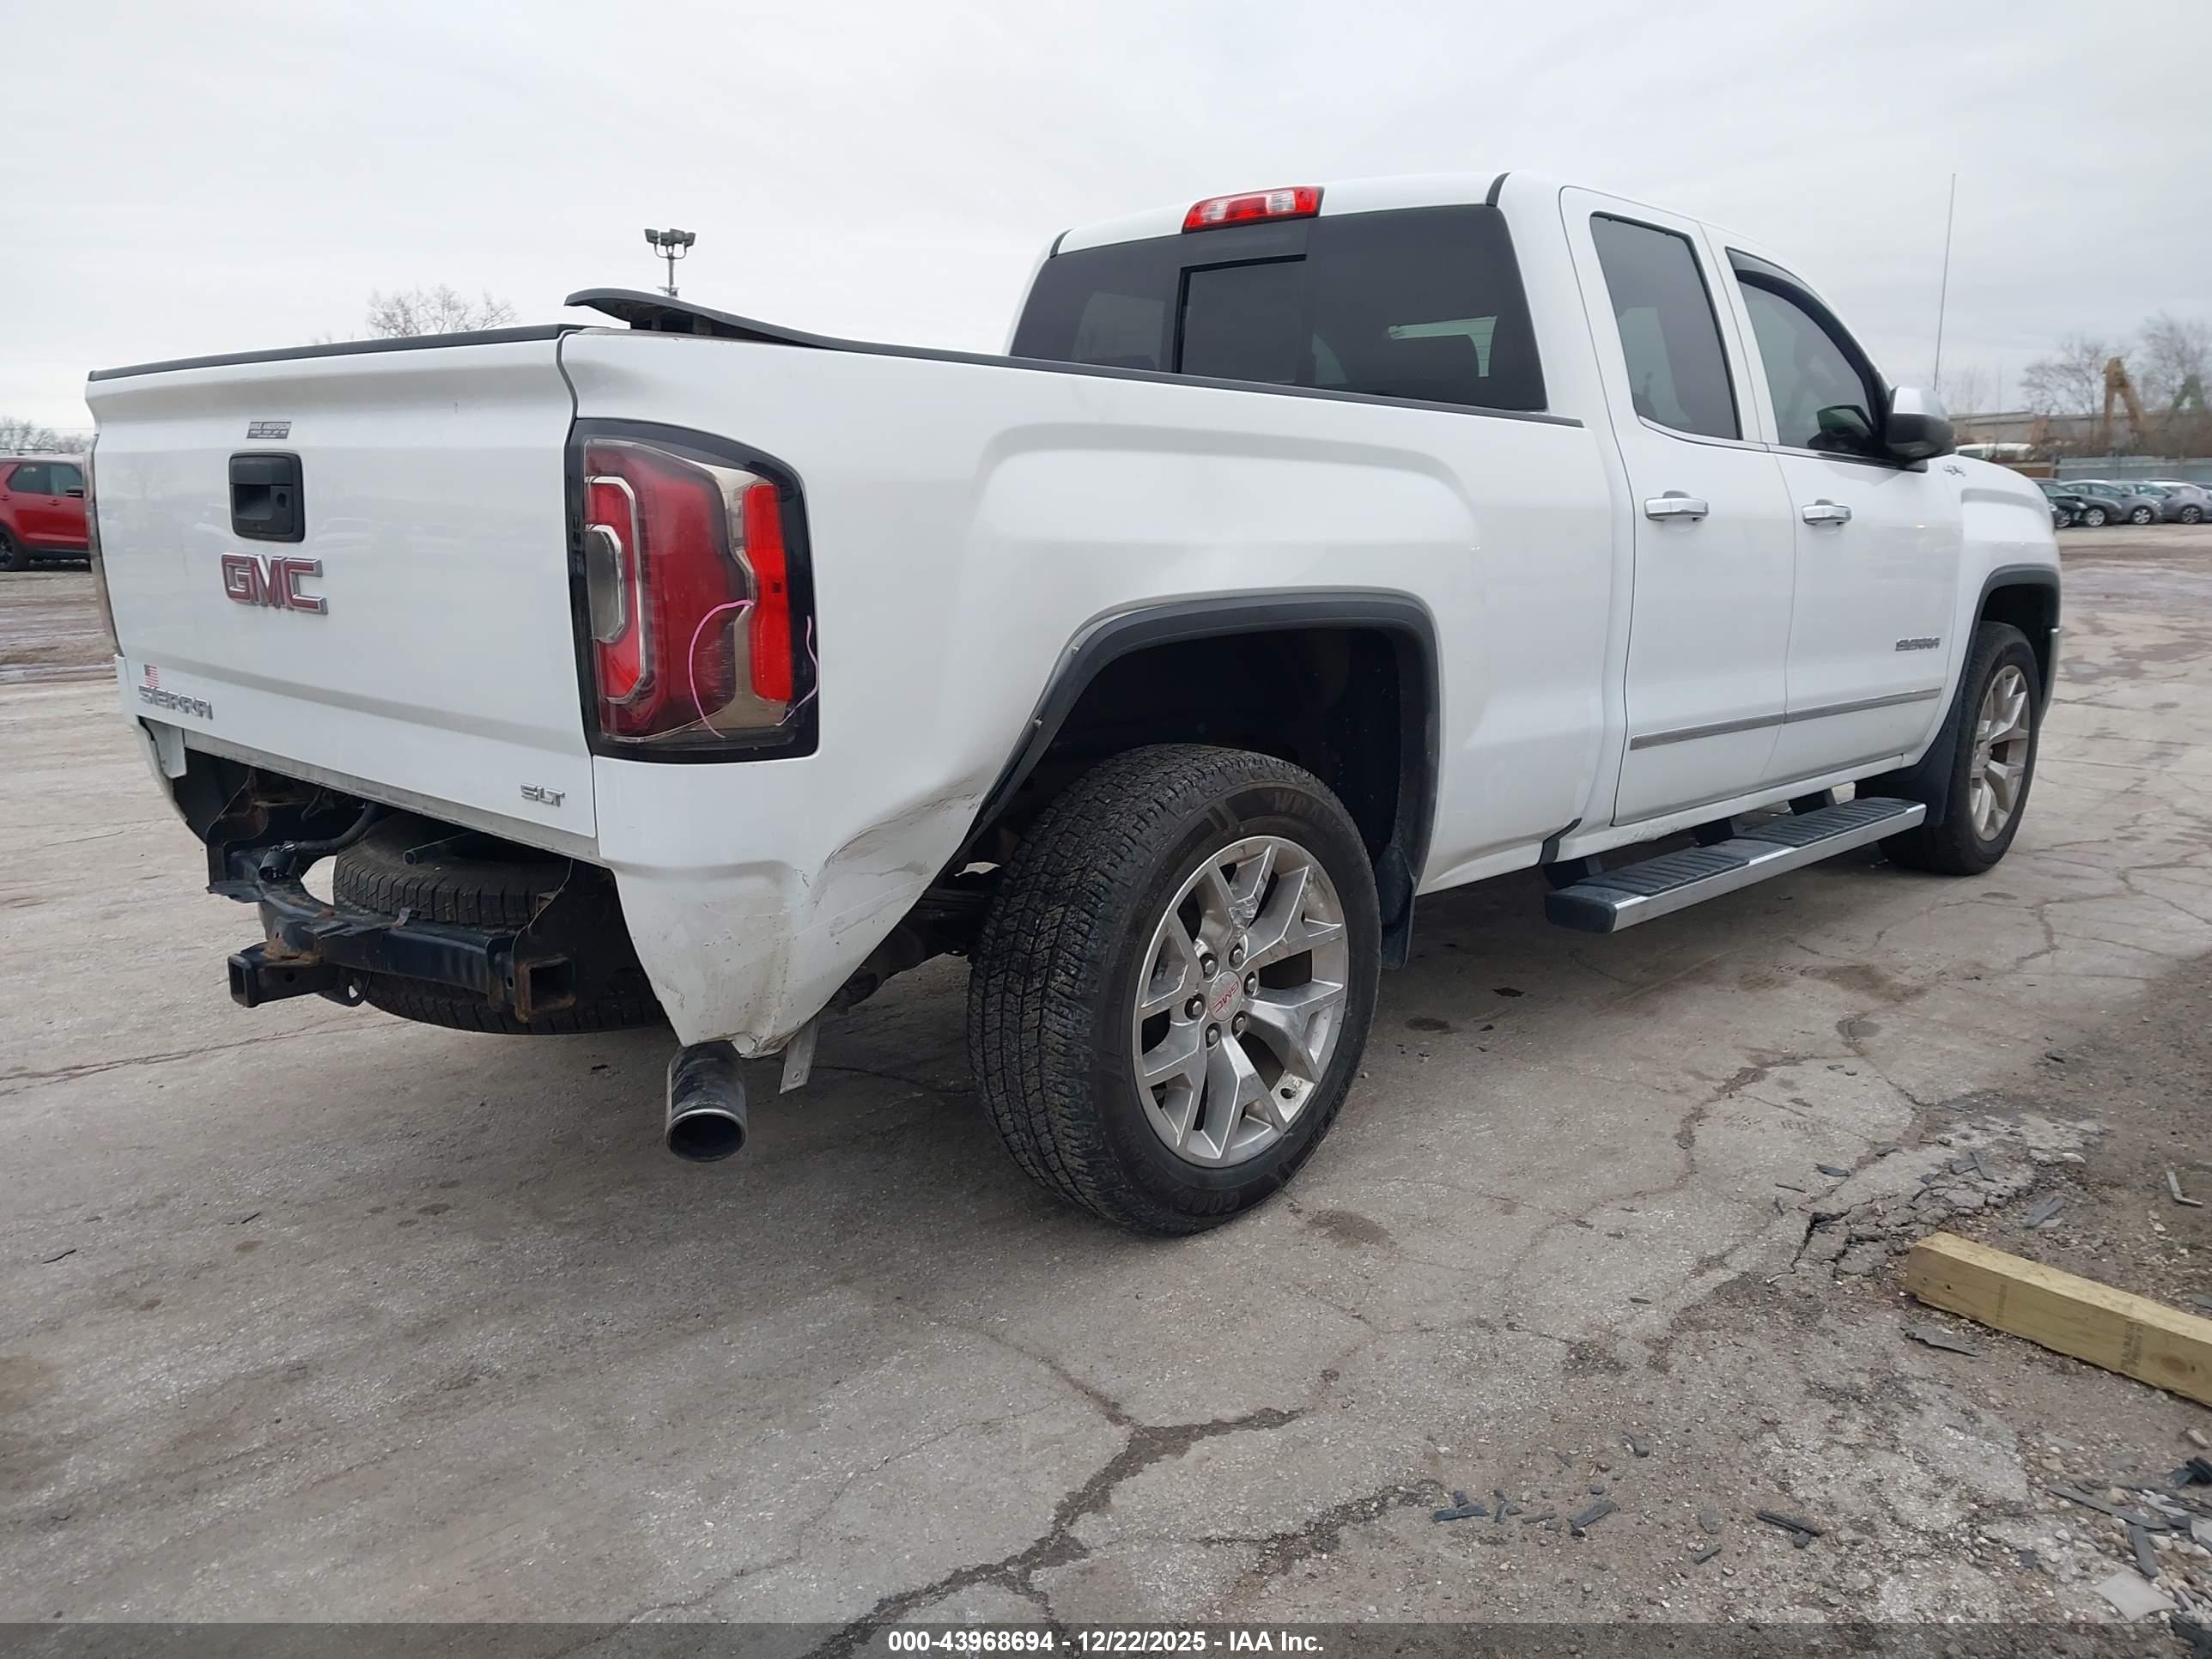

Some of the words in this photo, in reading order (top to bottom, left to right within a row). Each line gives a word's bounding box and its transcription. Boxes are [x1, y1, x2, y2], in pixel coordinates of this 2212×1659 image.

[221, 552, 328, 616] GMC
[138, 684, 213, 720] SIERRA
[520, 783, 566, 808] SLT
[1212, 981, 1239, 1013] GMC
